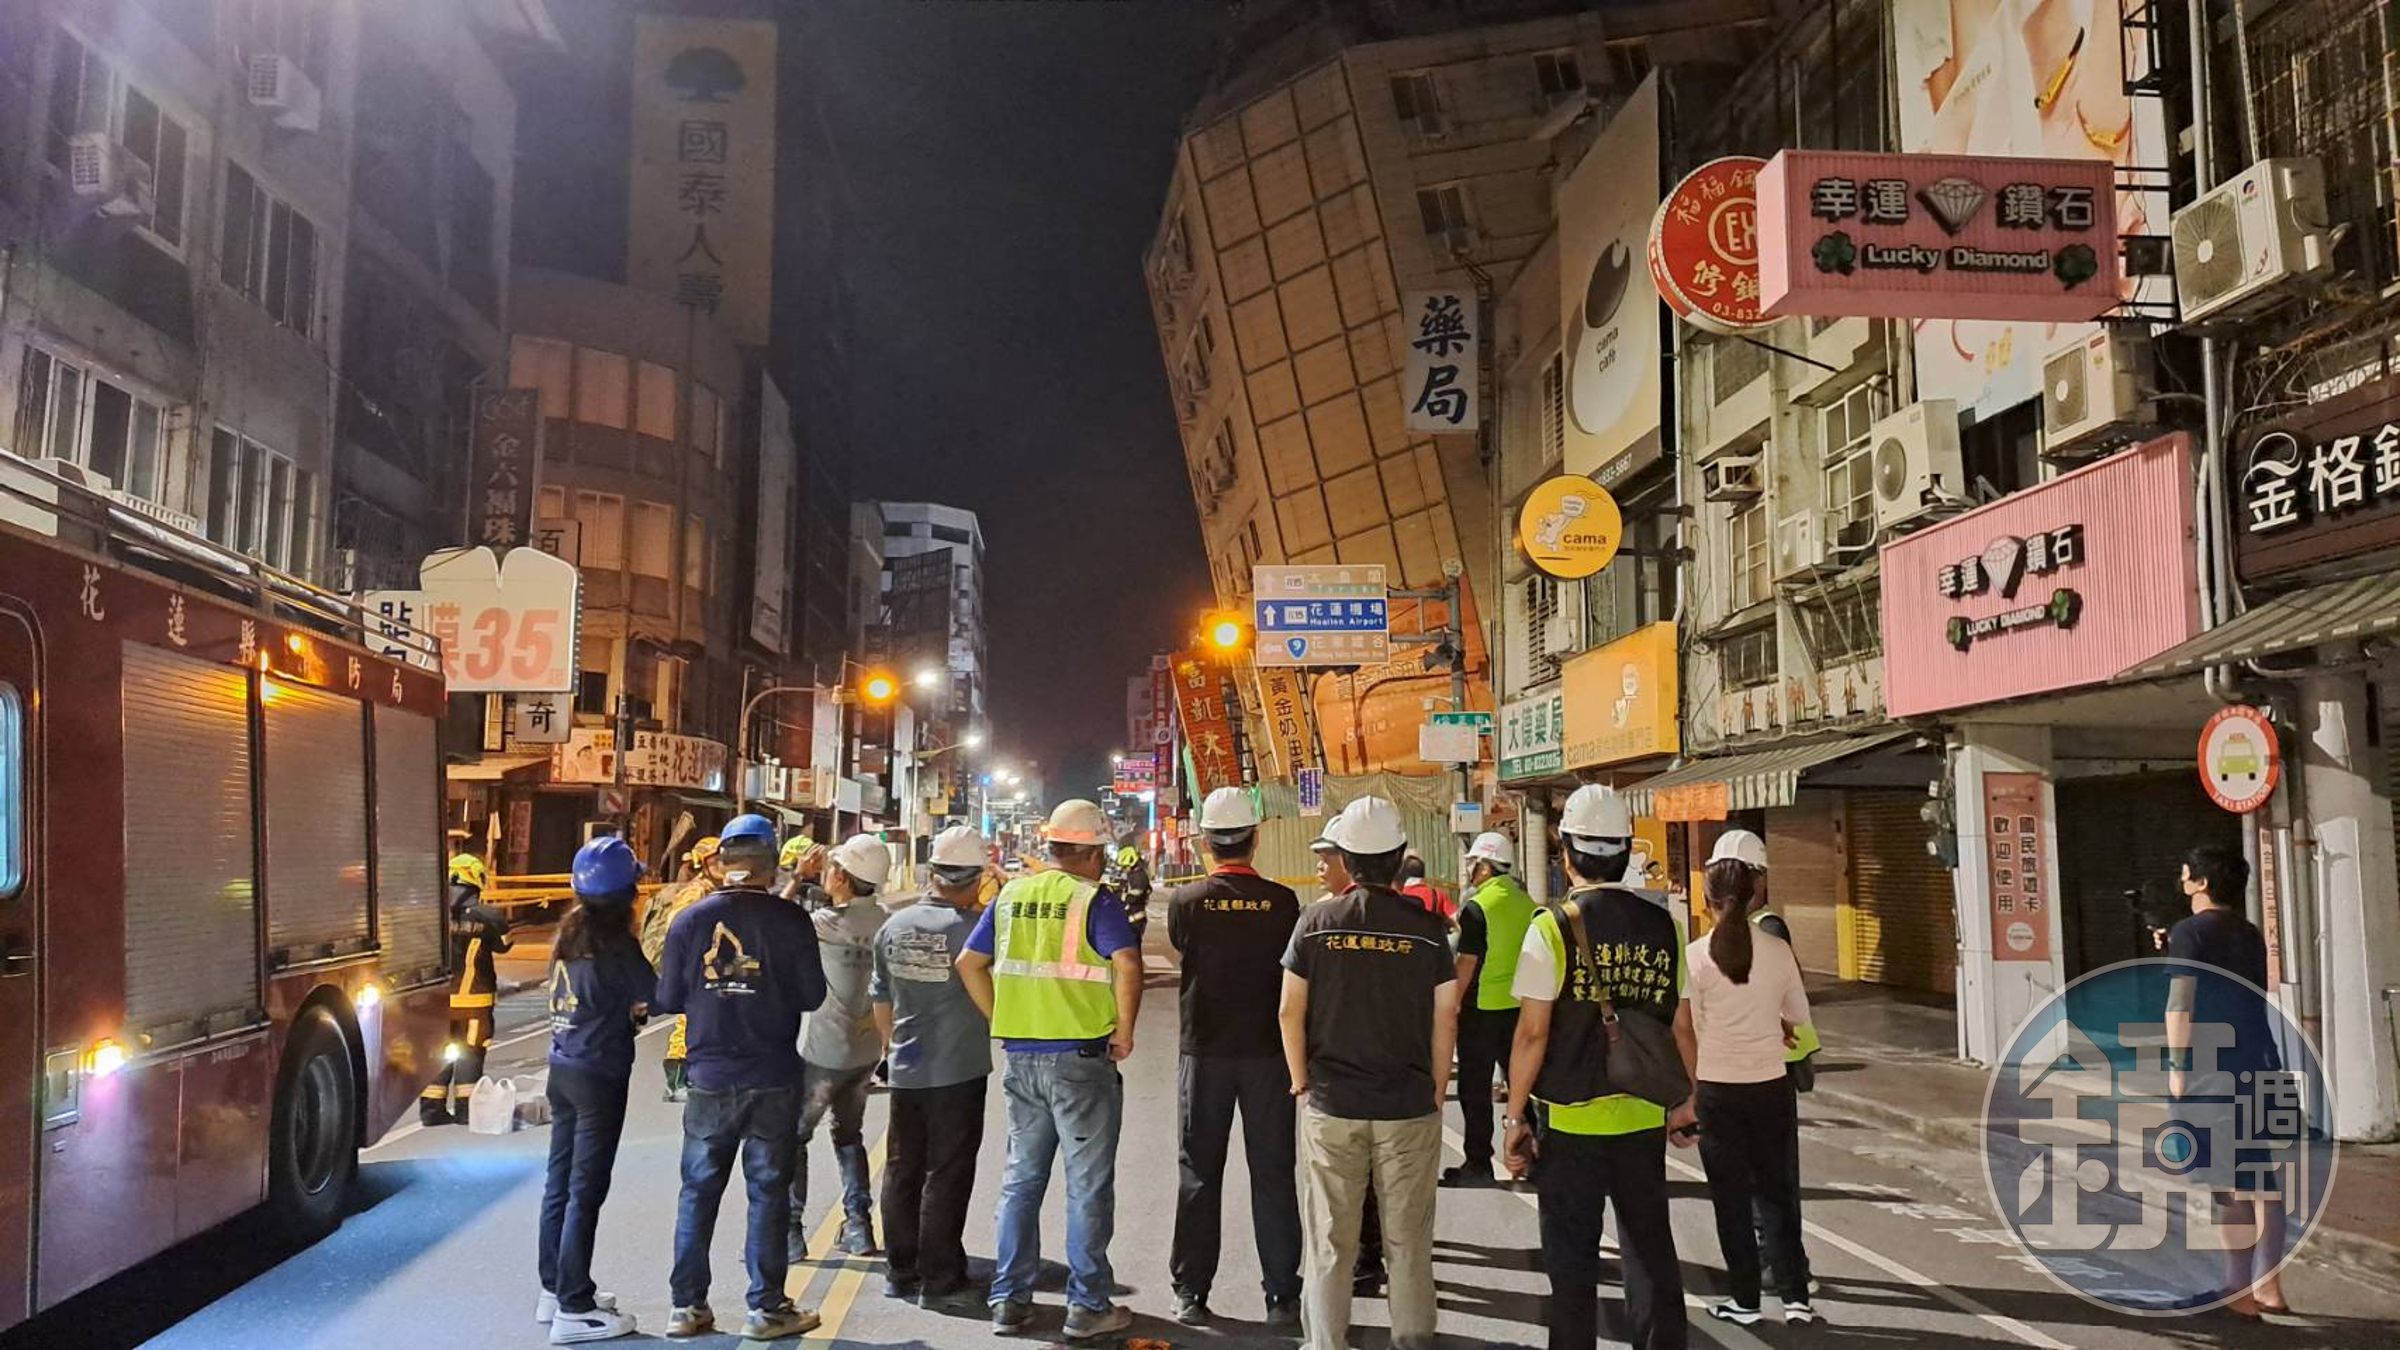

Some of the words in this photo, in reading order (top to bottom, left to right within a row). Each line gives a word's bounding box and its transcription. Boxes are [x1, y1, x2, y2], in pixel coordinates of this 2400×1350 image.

[1816, 178, 1908, 220] 幸運
[2003, 183, 2094, 227] 鑽石
[1866, 244, 1940, 270] Lucky
[1953, 246, 2049, 270] Diamond
[1595, 326, 1619, 354] cama
[1411, 295, 1472, 426] 藥局
[1562, 532, 1608, 545] cama
[1309, 618, 1345, 626] Hualien
[1349, 618, 1384, 627] Airport
[1310, 602, 1384, 617] 花蓮機場
[1966, 617, 1999, 637] LUCKY
[2000, 604, 2046, 628] DIAMOND
[465, 606, 559, 680] 35
[1291, 639, 1301, 651] 9
[525, 701, 557, 734] 奇
[1203, 899, 1272, 912] 花蓮縣政府
[1325, 935, 1414, 954] 花蓮縣政府
